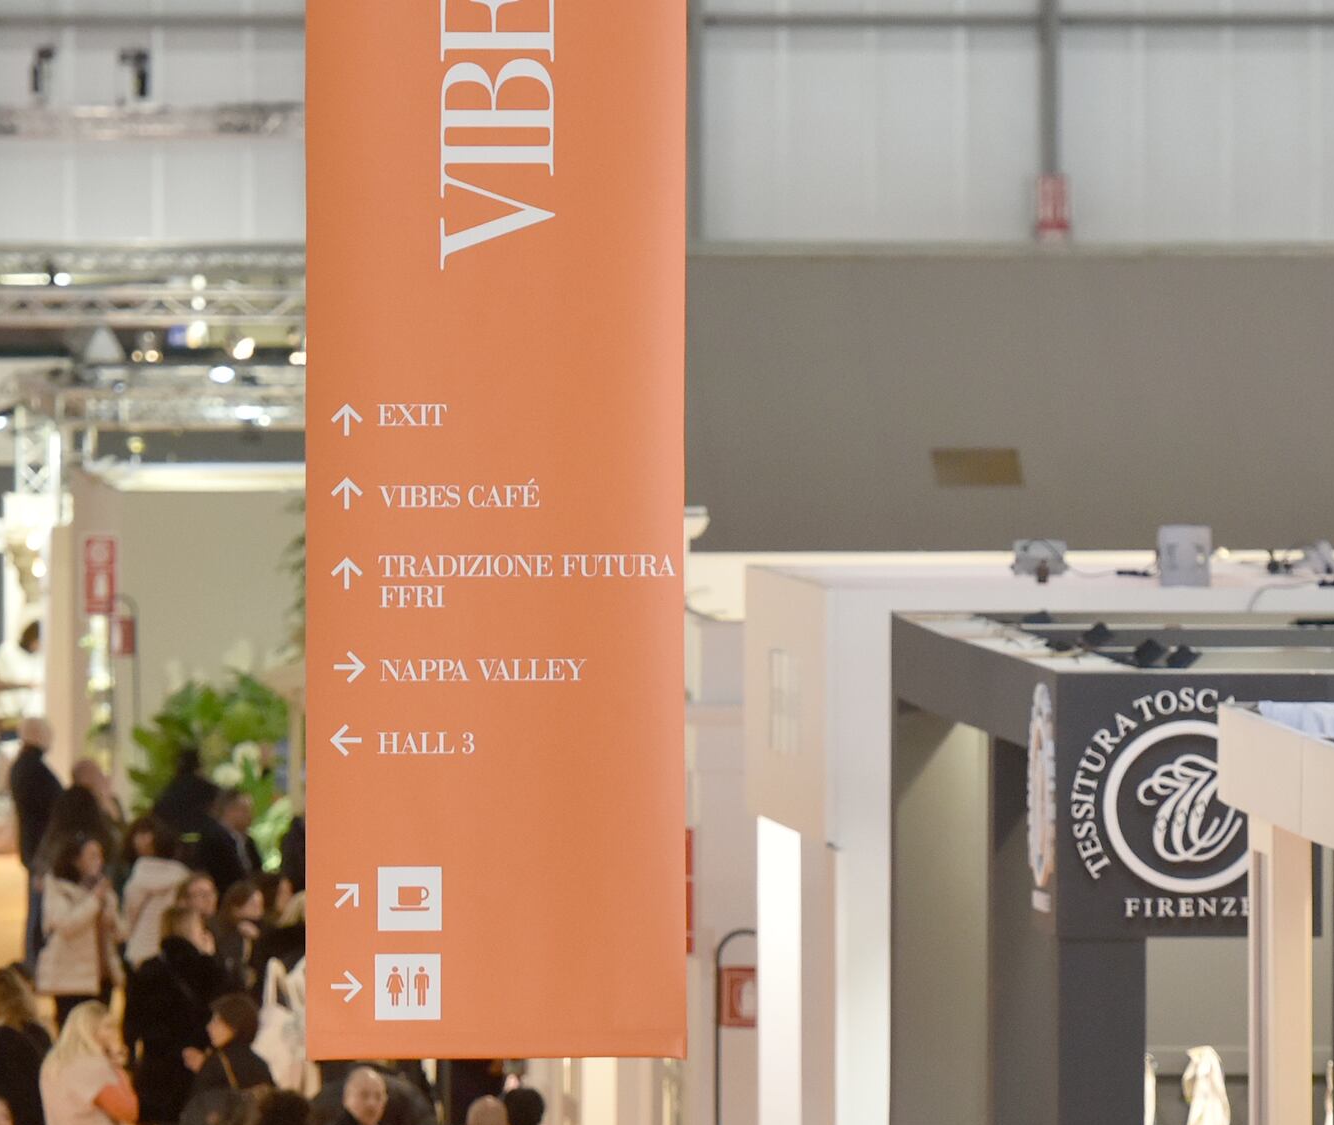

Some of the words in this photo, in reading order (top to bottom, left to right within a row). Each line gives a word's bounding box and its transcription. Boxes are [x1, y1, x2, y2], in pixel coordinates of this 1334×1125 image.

[377, 404, 447, 427] EXIT
[378, 485, 461, 508] VIBES
[467, 478, 540, 508] CAFÉ
[378, 555, 553, 577] TRADIZIONE
[563, 555, 677, 577] FUTURA
[379, 586, 445, 608] FFRI
[379, 659, 470, 682] NAPPA
[476, 659, 587, 681] VALLEY
[377, 732, 455, 754] HALL
[462, 733, 475, 754] 3
[1071, 712, 1139, 880] TESSITURA
